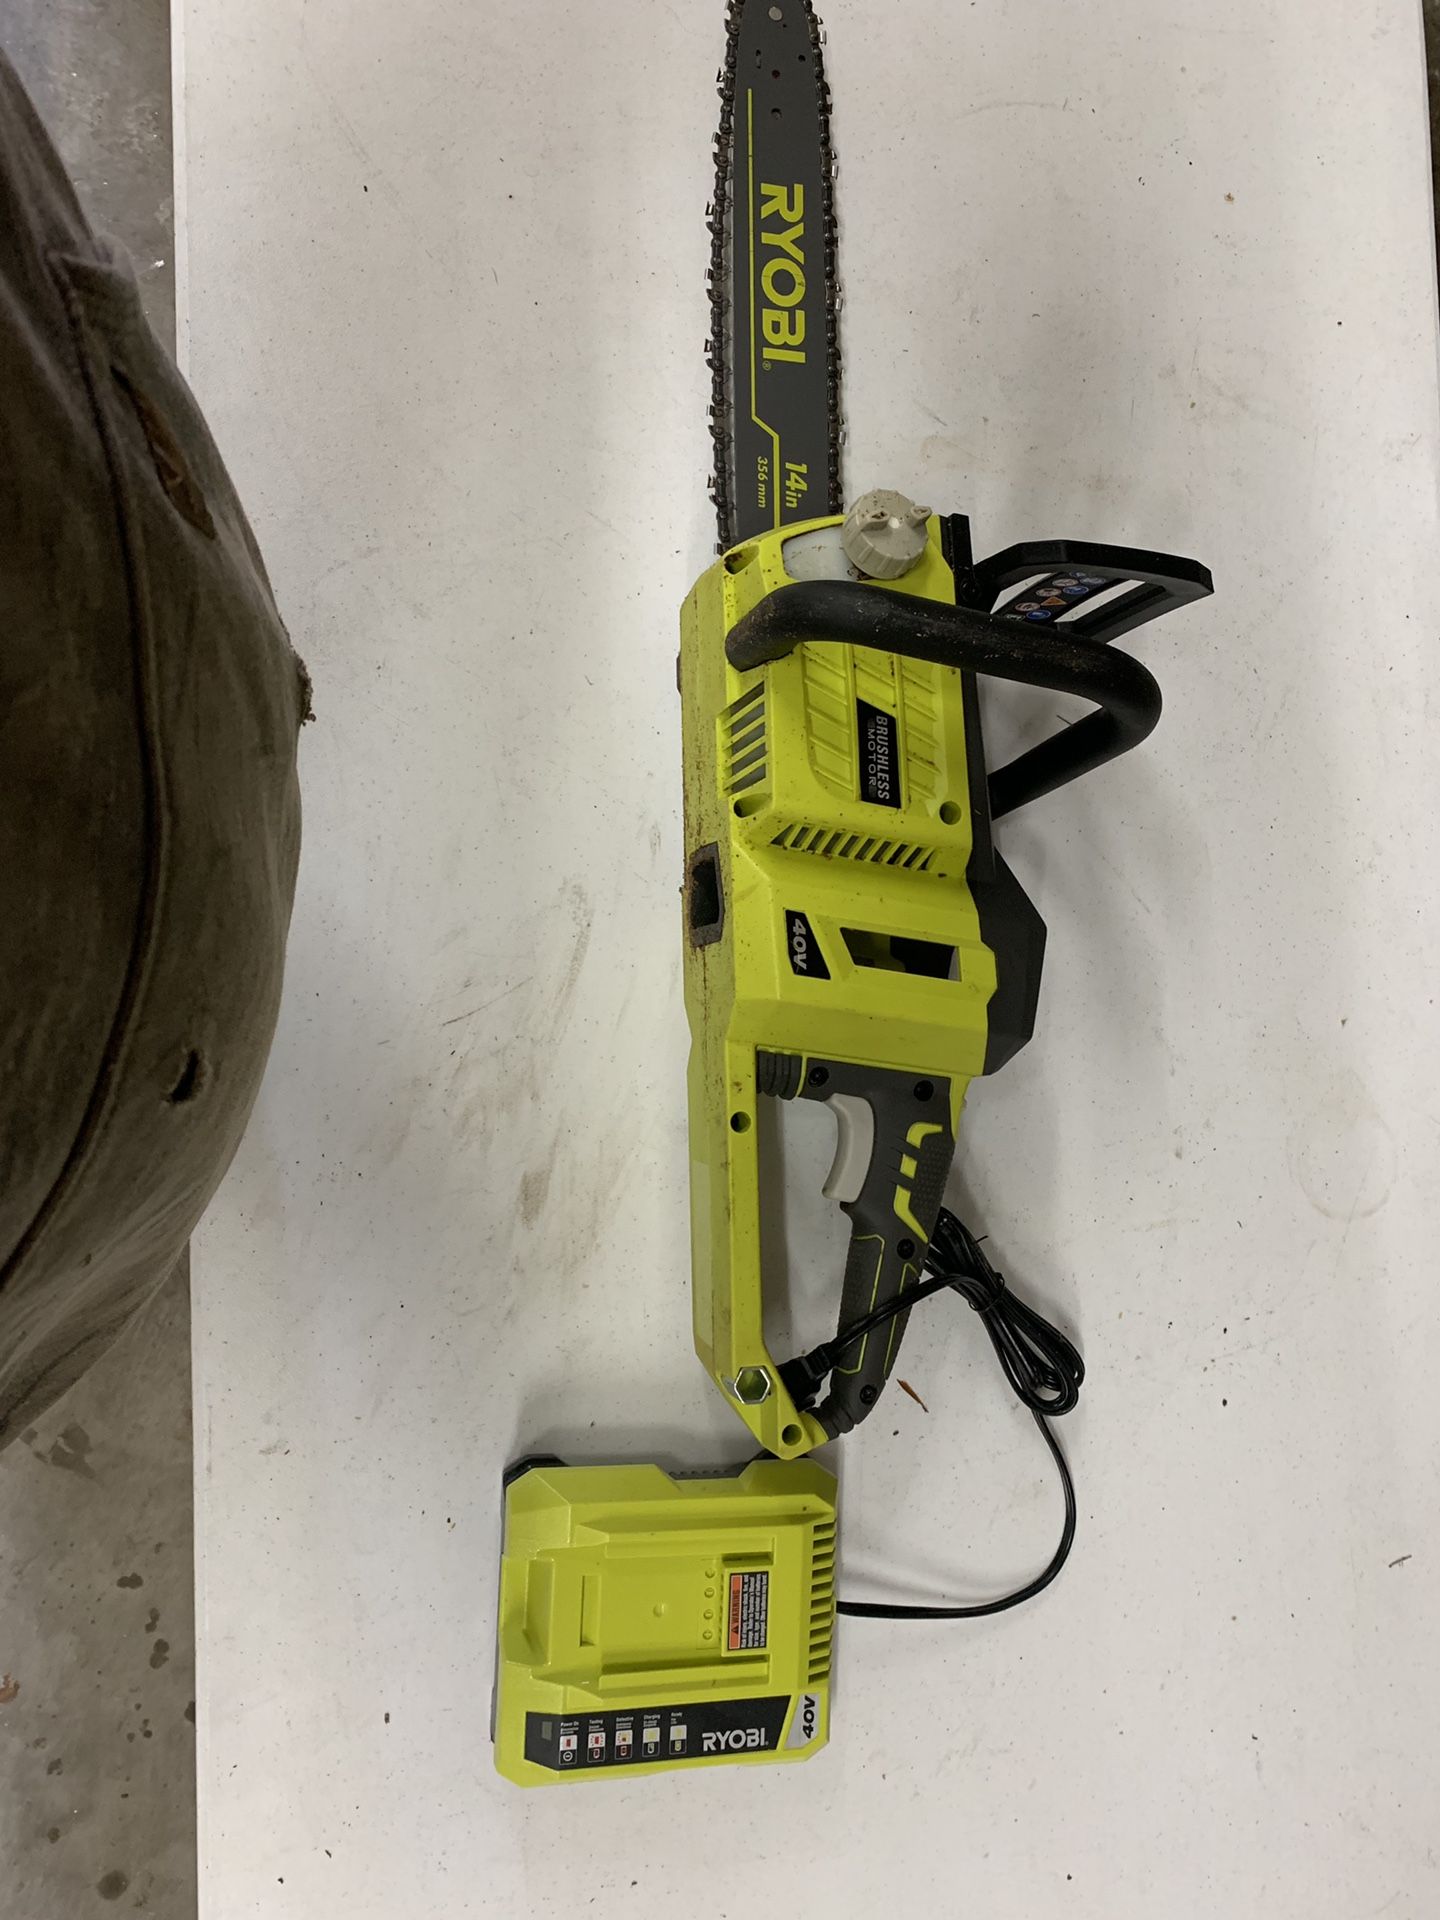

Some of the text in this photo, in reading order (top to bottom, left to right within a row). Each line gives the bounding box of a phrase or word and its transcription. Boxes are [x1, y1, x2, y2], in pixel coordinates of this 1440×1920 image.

[761, 183, 806, 364] RYOBI
[757, 456, 768, 508] 356 mm
[867, 728, 877, 786] MOTOR
[876, 715, 890, 800] BRUSHLESS
[793, 918, 807, 970] 40V
[702, 1727, 766, 1752] RYOBI
[802, 1695, 816, 1739] 40V
